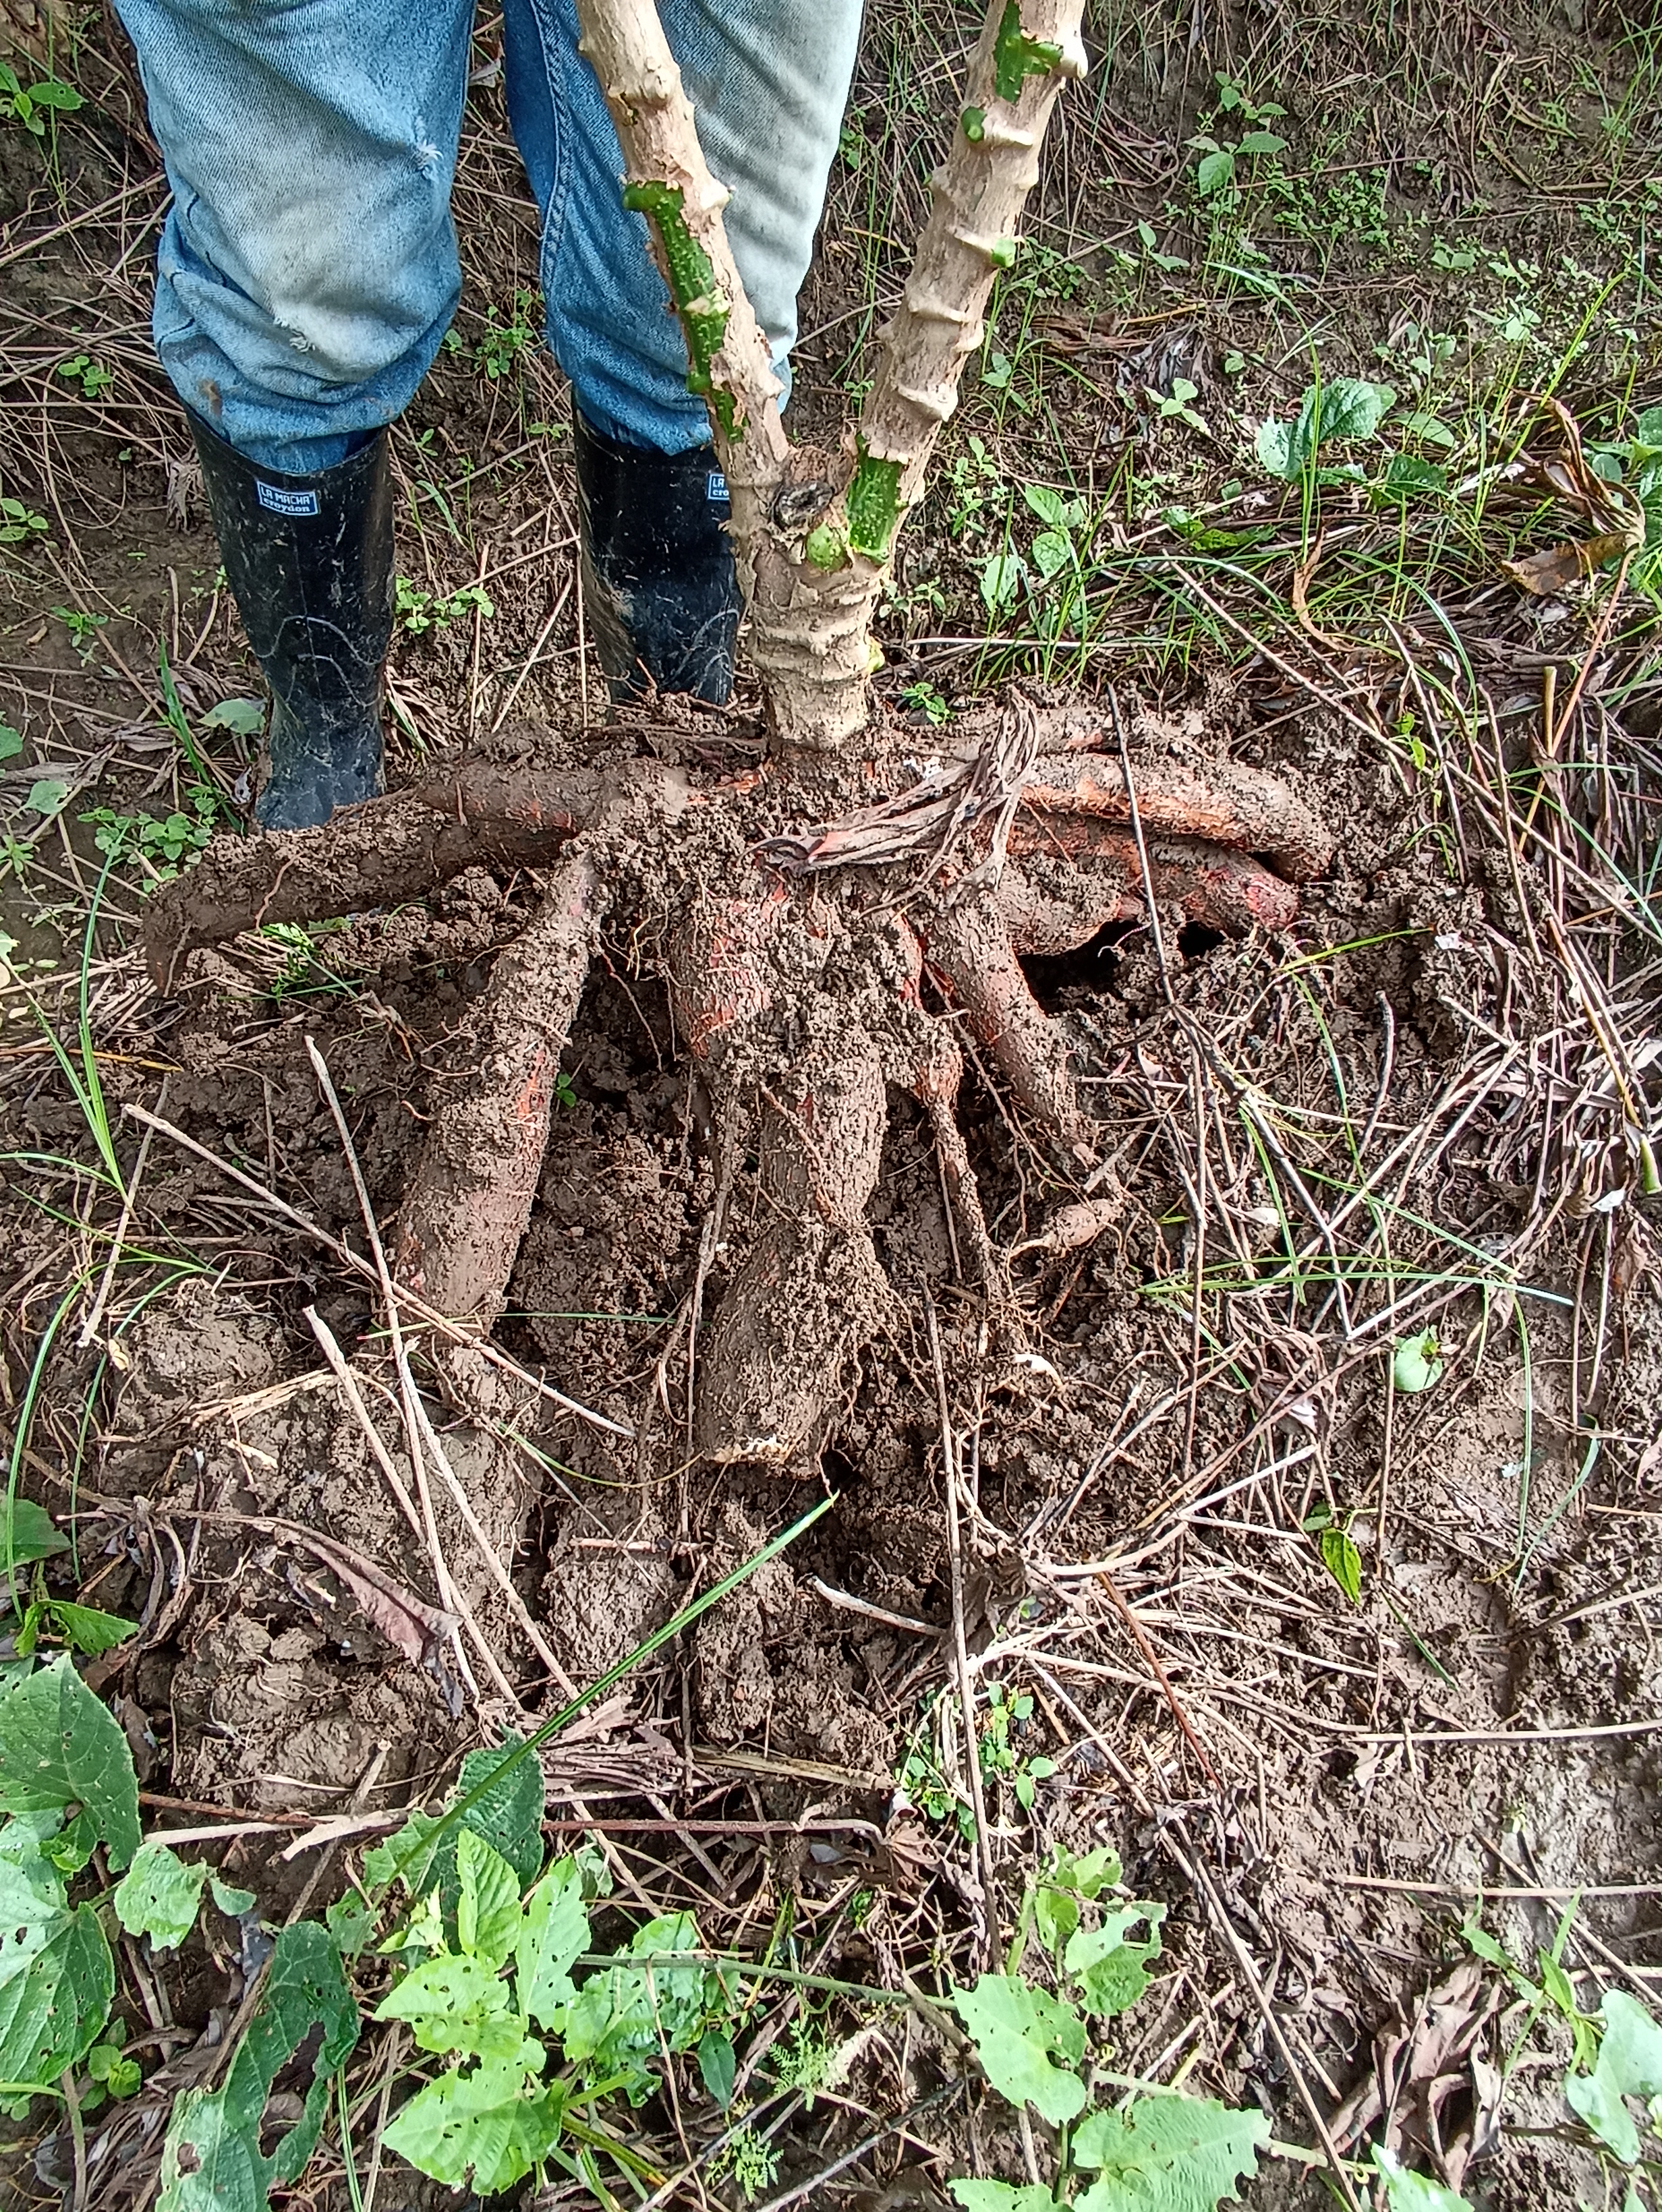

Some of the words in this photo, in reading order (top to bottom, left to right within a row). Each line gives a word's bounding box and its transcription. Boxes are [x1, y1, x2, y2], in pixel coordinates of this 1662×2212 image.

[712, 477, 724, 488] LA
[261, 486, 273, 499] LA
[275, 493, 310, 504] MACHA
[263, 498, 310, 512] croydon
